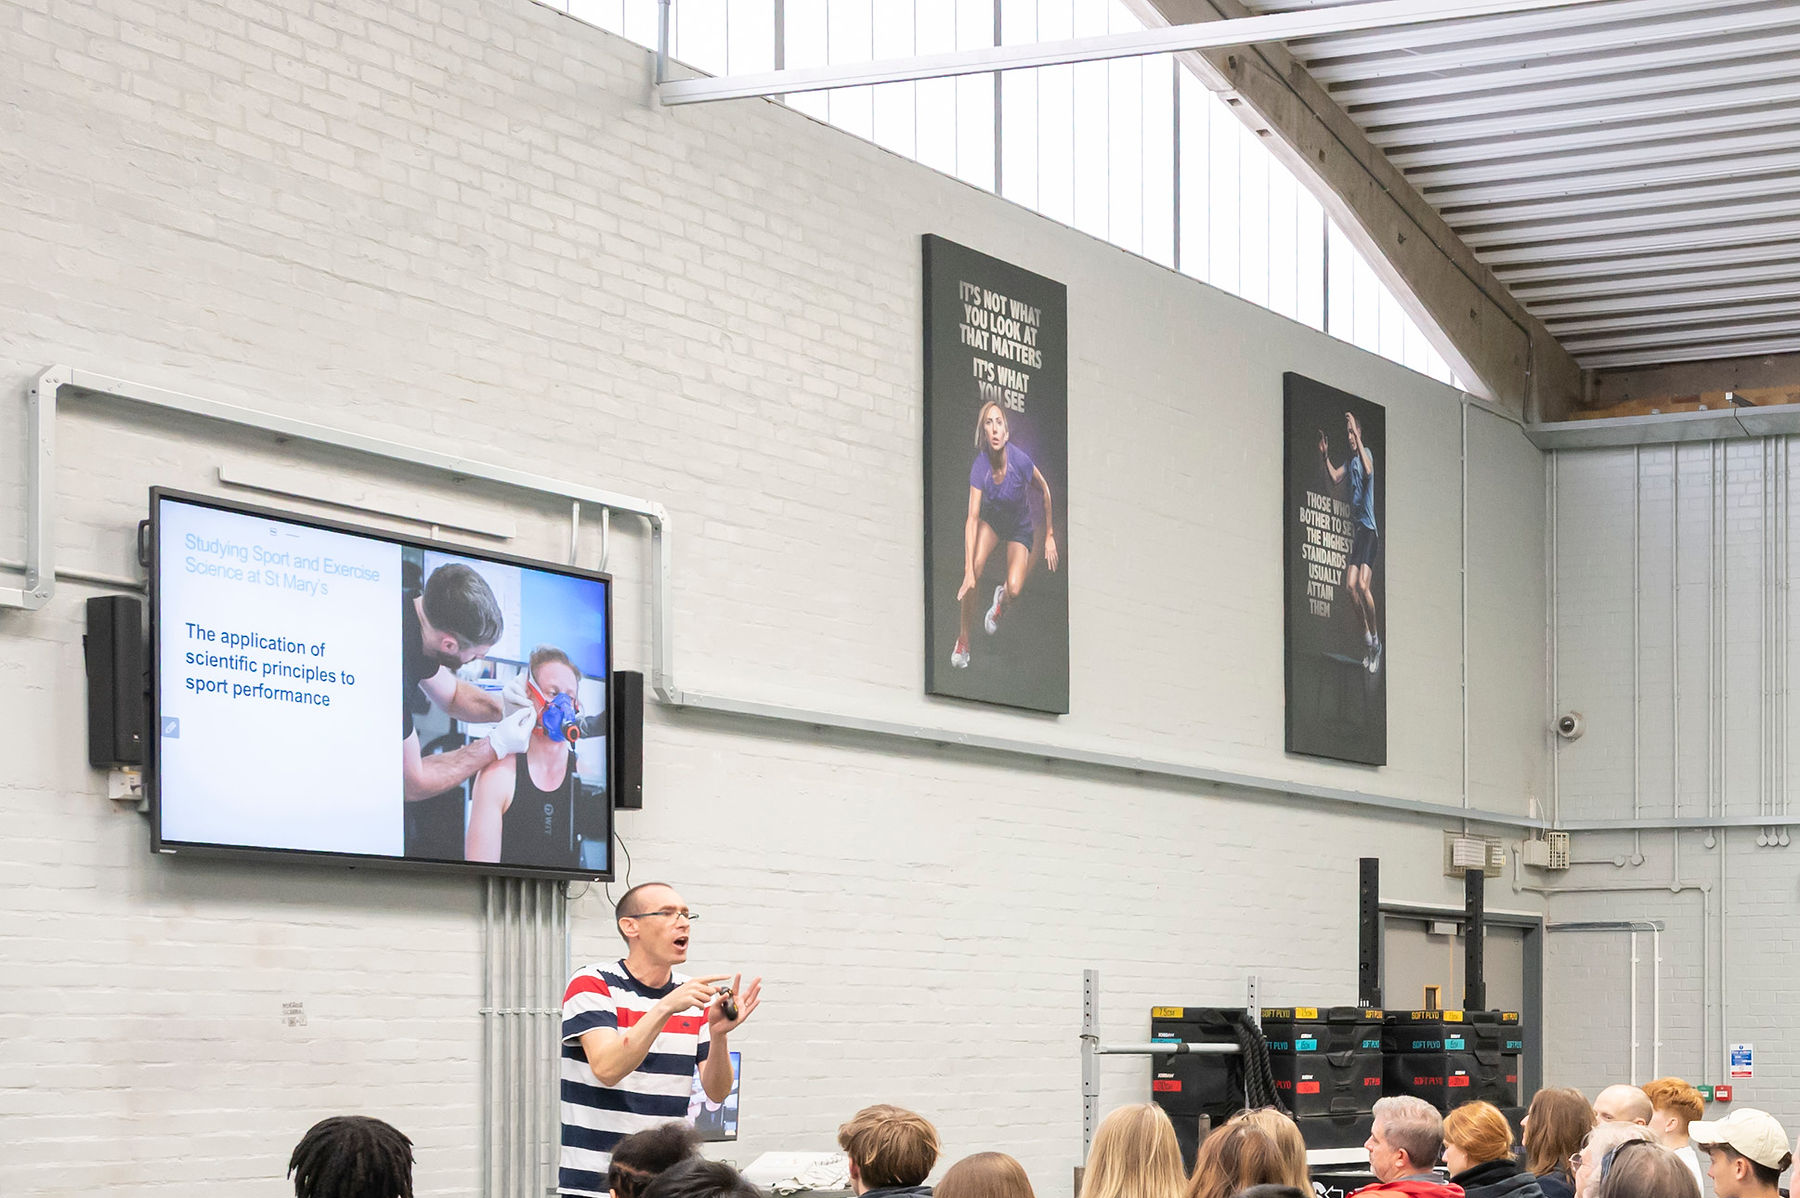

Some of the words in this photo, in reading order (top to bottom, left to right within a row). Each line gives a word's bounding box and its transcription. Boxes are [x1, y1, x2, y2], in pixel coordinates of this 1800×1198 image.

[960, 280, 981, 305] IT'S
[984, 290, 1007, 315] NOT
[1010, 299, 1041, 327] WHAT
[964, 304, 988, 330] YOU
[991, 313, 1021, 341] LOOK
[1024, 326, 1038, 346] AT
[960, 323, 989, 351] THAT
[992, 335, 1042, 369] MATTERS
[973, 357, 995, 382] IT'S
[997, 365, 1029, 393] WHAT
[978, 380, 1001, 402] YOU
[1004, 389, 1025, 413] SEE
[1300, 507, 1330, 530] BOTHER
[1331, 516, 1341, 533] TO
[1307, 491, 1331, 513] THOSE
[1333, 499, 1350, 518] WHO
[1307, 527, 1321, 546] THE
[1323, 531, 1354, 554] HIGHEST
[185, 532, 248, 563] Studying
[253, 545, 289, 566] Sport
[294, 555, 319, 571] and
[323, 558, 380, 582] Exercise
[185, 556, 243, 581] Science
[247, 569, 260, 583] at
[265, 570, 280, 587] St
[1302, 543, 1346, 570] STANDARDS
[1309, 562, 1341, 585] USUALLY
[1307, 580, 1333, 601] ATTAIN
[1310, 599, 1331, 617] THEM
[185, 622, 216, 642] The
[221, 632, 305, 654] application
[310, 642, 325, 657] of
[186, 650, 257, 673] scientific
[262, 661, 336, 684] principles
[341, 670, 355, 685] to
[186, 677, 228, 694] sport
[233, 683, 330, 707] performance
